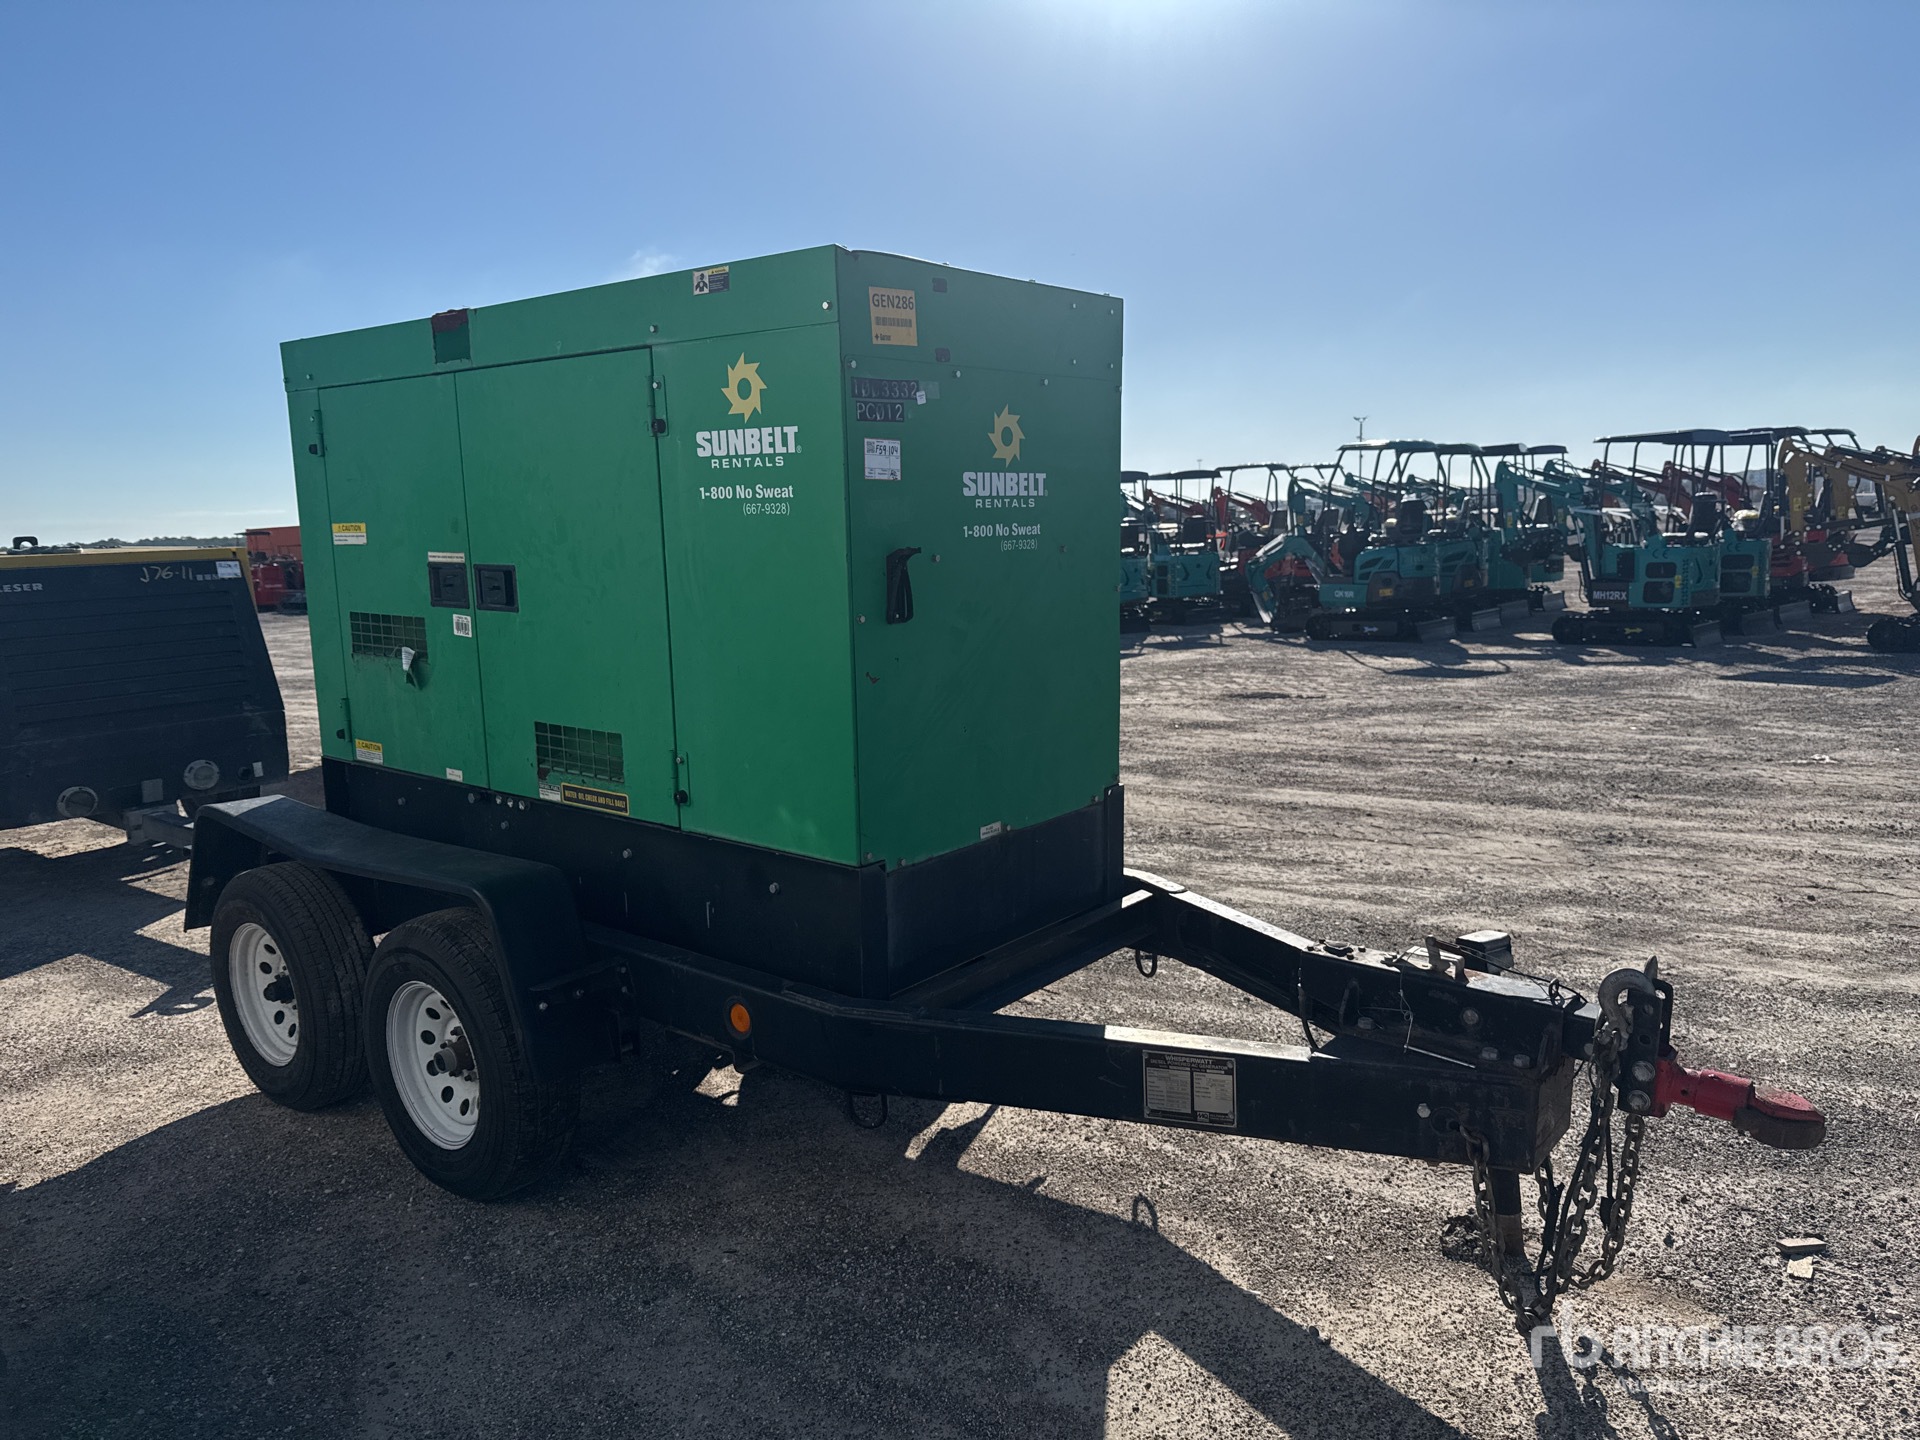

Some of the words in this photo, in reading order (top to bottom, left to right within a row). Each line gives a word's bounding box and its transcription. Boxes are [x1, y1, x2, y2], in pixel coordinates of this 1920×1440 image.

[872, 293, 914, 310] GEN286
[695, 426, 799, 457] SUNBELT
[711, 456, 784, 469] RENTALS
[962, 471, 1047, 497] SUNBELT
[699, 486, 733, 500] 1-800
[735, 485, 753, 499] No
[755, 484, 794, 499] Sweat
[742, 502, 790, 516] (667-9328)
[975, 498, 1036, 509] RENTALS
[963, 524, 994, 538] 1-800
[995, 523, 1010, 537] No
[1011, 522, 1041, 536] Sweat
[1000, 538, 1038, 552] (667-9328)
[0, 583, 43, 592] ESER
[1592, 590, 1627, 601] MH12RX
[1165, 1055, 1213, 1065] WHISPERWATT
